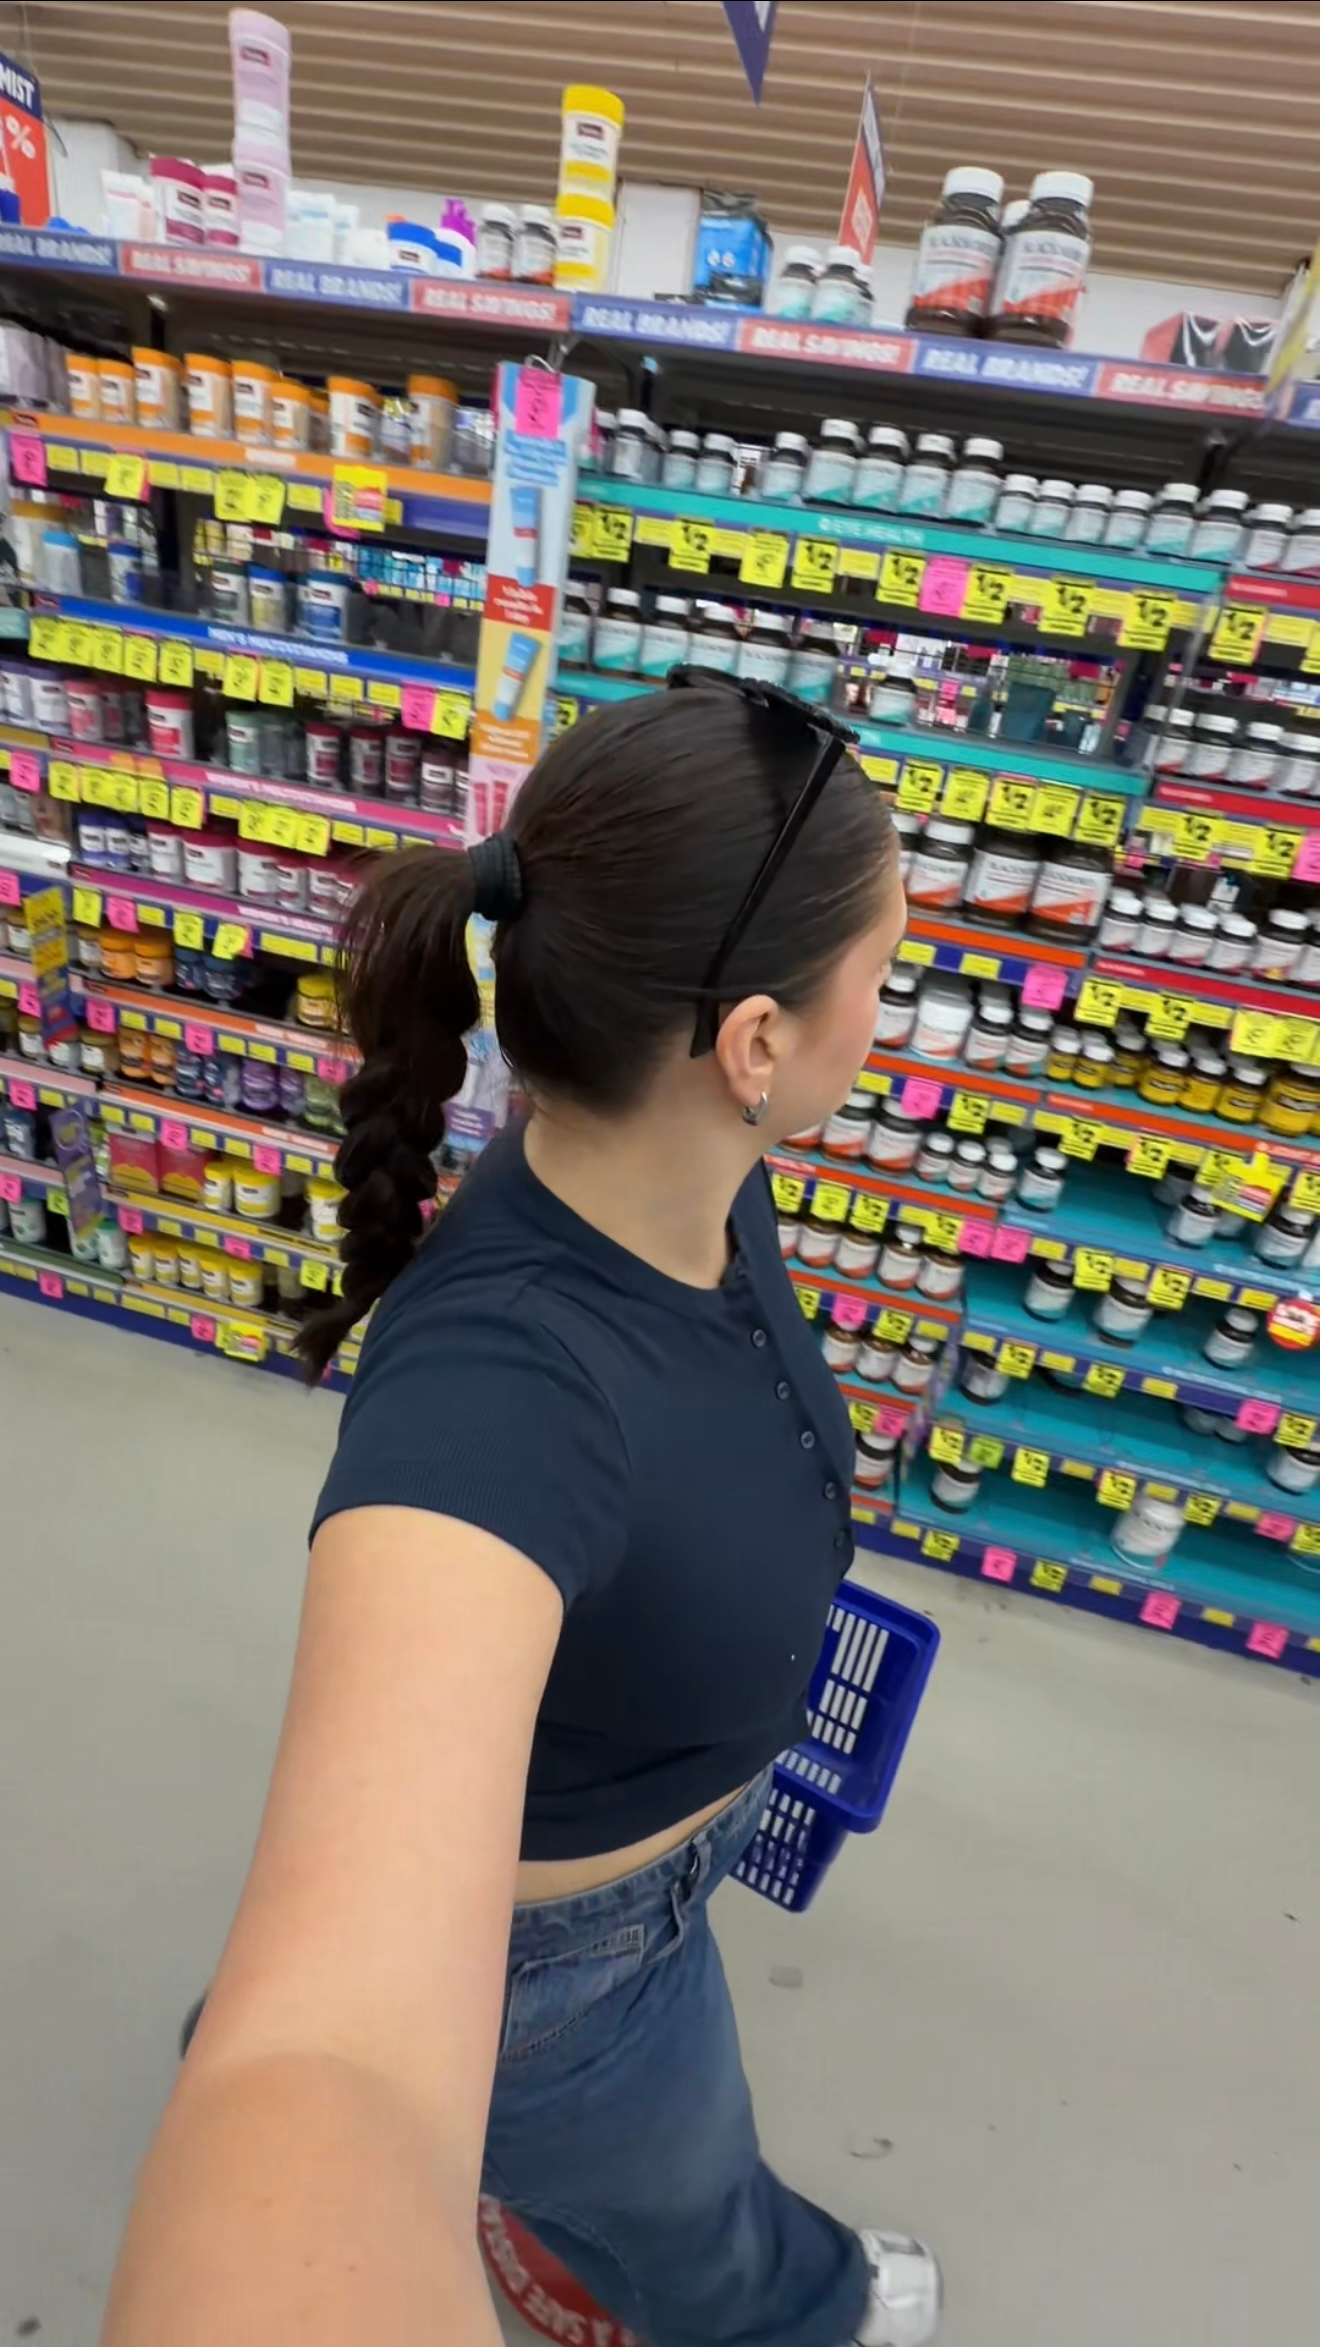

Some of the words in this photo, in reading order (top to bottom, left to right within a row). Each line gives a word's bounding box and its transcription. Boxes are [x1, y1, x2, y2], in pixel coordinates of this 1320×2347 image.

[582, 307, 633, 332] REAL
[635, 312, 731, 344] BRANDS!
[750, 327, 802, 350] REAL
[804, 333, 900, 364] SAVINGS!
[922, 348, 979, 375] REAL
[981, 356, 1091, 387] BRANDS!
[1111, 372, 1171, 397] REAL
[1172, 379, 1265, 410] SAVINGS
[601, 514, 626, 540] 1/2
[682, 525, 708, 551] 1/2
[806, 545, 831, 570] 1/2
[893, 558, 918, 584] 1/2
[976, 574, 1003, 601] 1/2
[1057, 586, 1085, 613] 1/2
[1138, 600, 1167, 627] 1/2
[1227, 612, 1255, 640] 1/2
[908, 769, 933, 792] 1/2
[1002, 785, 1027, 809] 1/2
[1091, 801, 1117, 825] 1/2
[1185, 817, 1211, 841] 1/2
[1267, 833, 1294, 857] 1/2
[1091, 985, 1114, 1006] 1/2
[1163, 1000, 1187, 1021] 1/2
